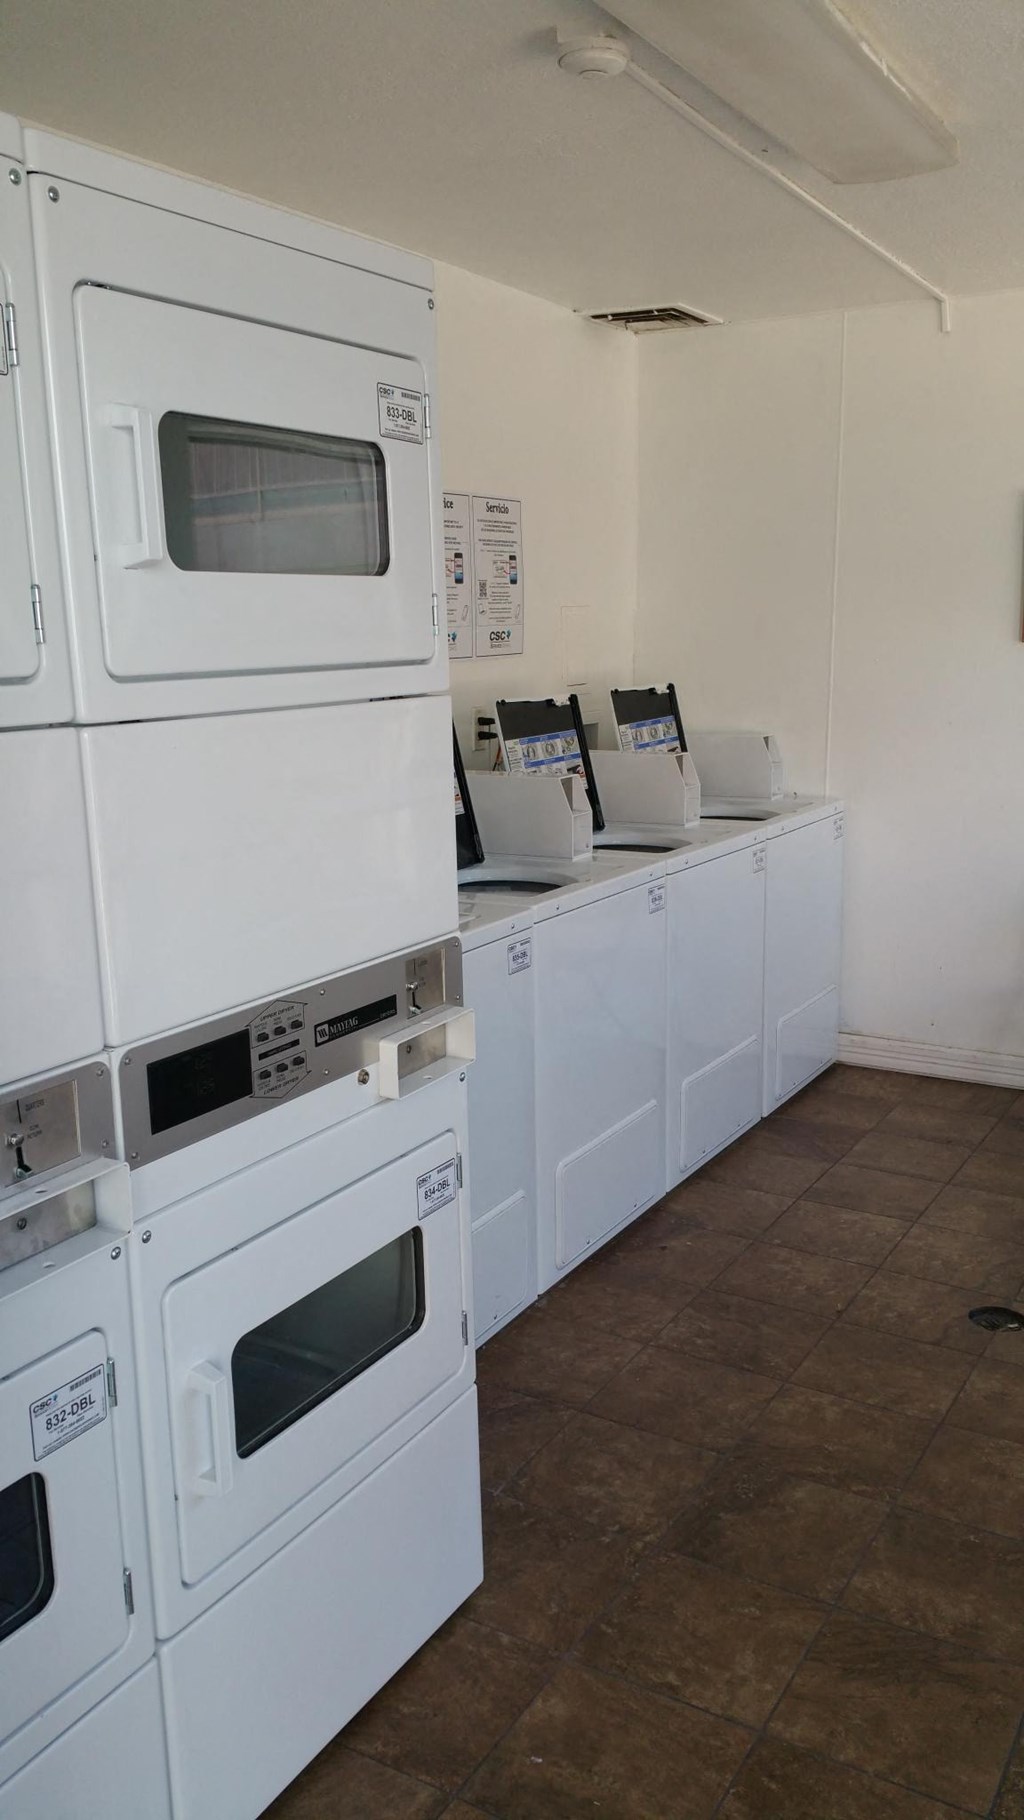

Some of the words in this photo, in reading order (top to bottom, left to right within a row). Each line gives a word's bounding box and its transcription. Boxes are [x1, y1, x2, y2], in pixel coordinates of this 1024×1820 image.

[386, 405, 417, 423] 833-DBL
[485, 501, 510, 514] Servicio
[489, 630, 506, 641] CSC
[329, 1016, 359, 1035] MAYTAG
[424, 1178, 451, 1200] 834-DBL
[33, 1398, 52, 1414] CSC
[45, 1393, 96, 1431] 832-DBL
